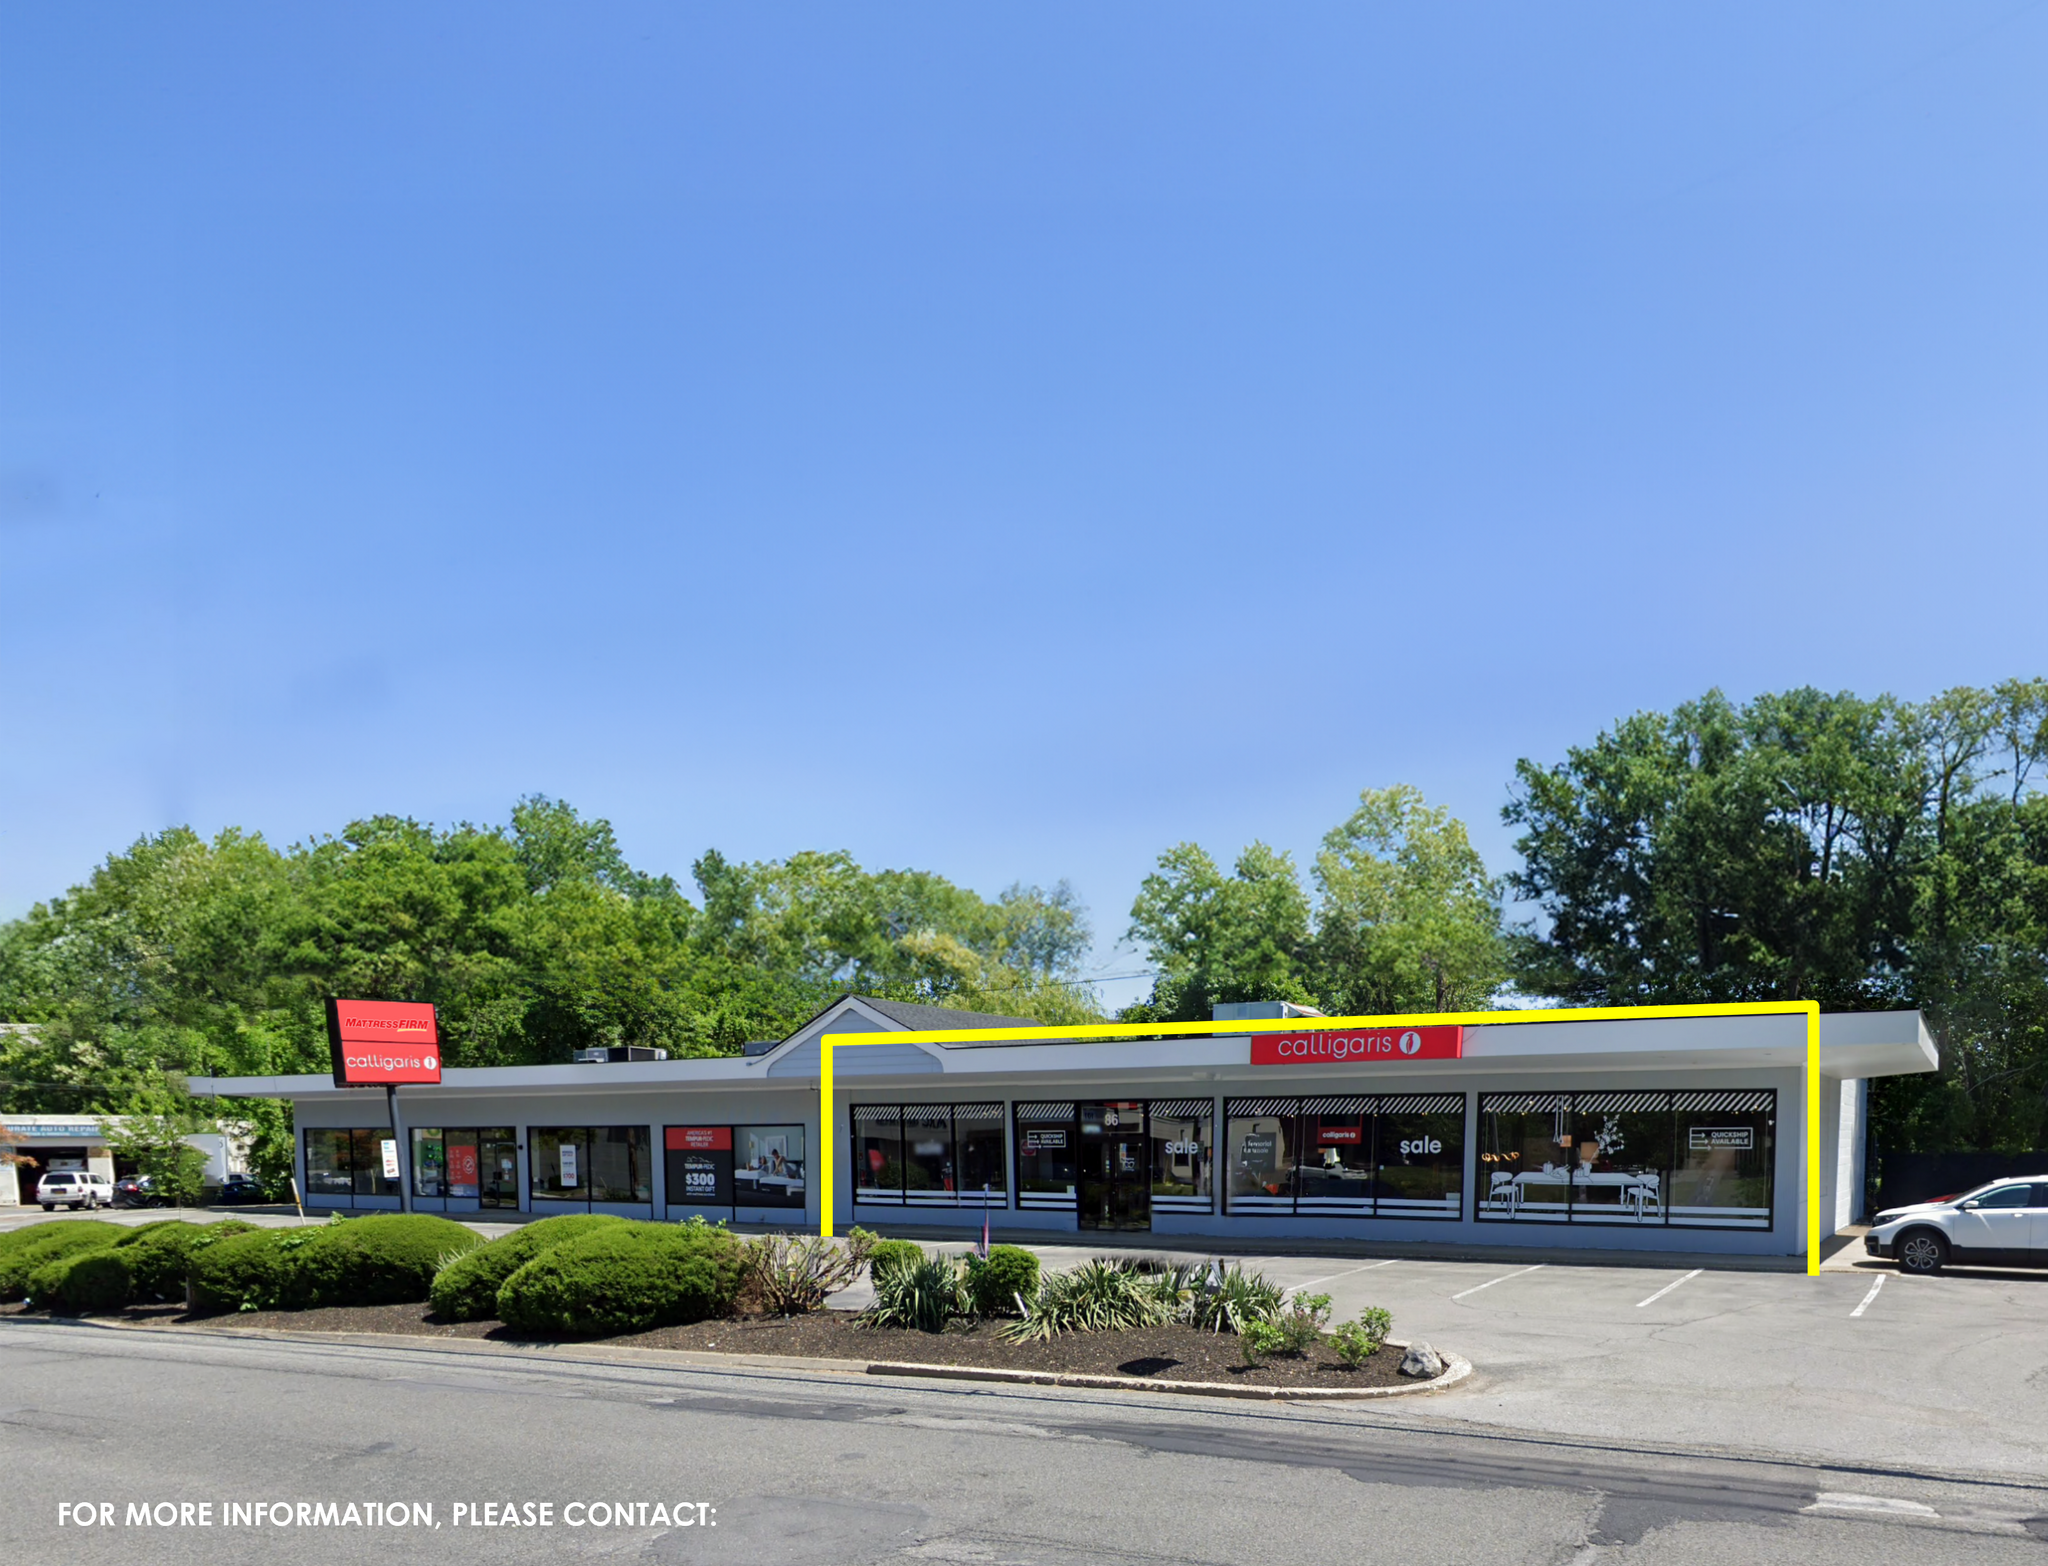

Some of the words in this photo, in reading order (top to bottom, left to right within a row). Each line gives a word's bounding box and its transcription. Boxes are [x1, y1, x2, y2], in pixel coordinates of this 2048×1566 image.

[1278, 1033, 1392, 1059] calligaris
[346, 1054, 421, 1071] calligaris
[1104, 1114, 1119, 1126] 86
[1165, 1137, 1198, 1154] sale
[1400, 1135, 1442, 1154] sale
[685, 1172, 716, 1186] $300
